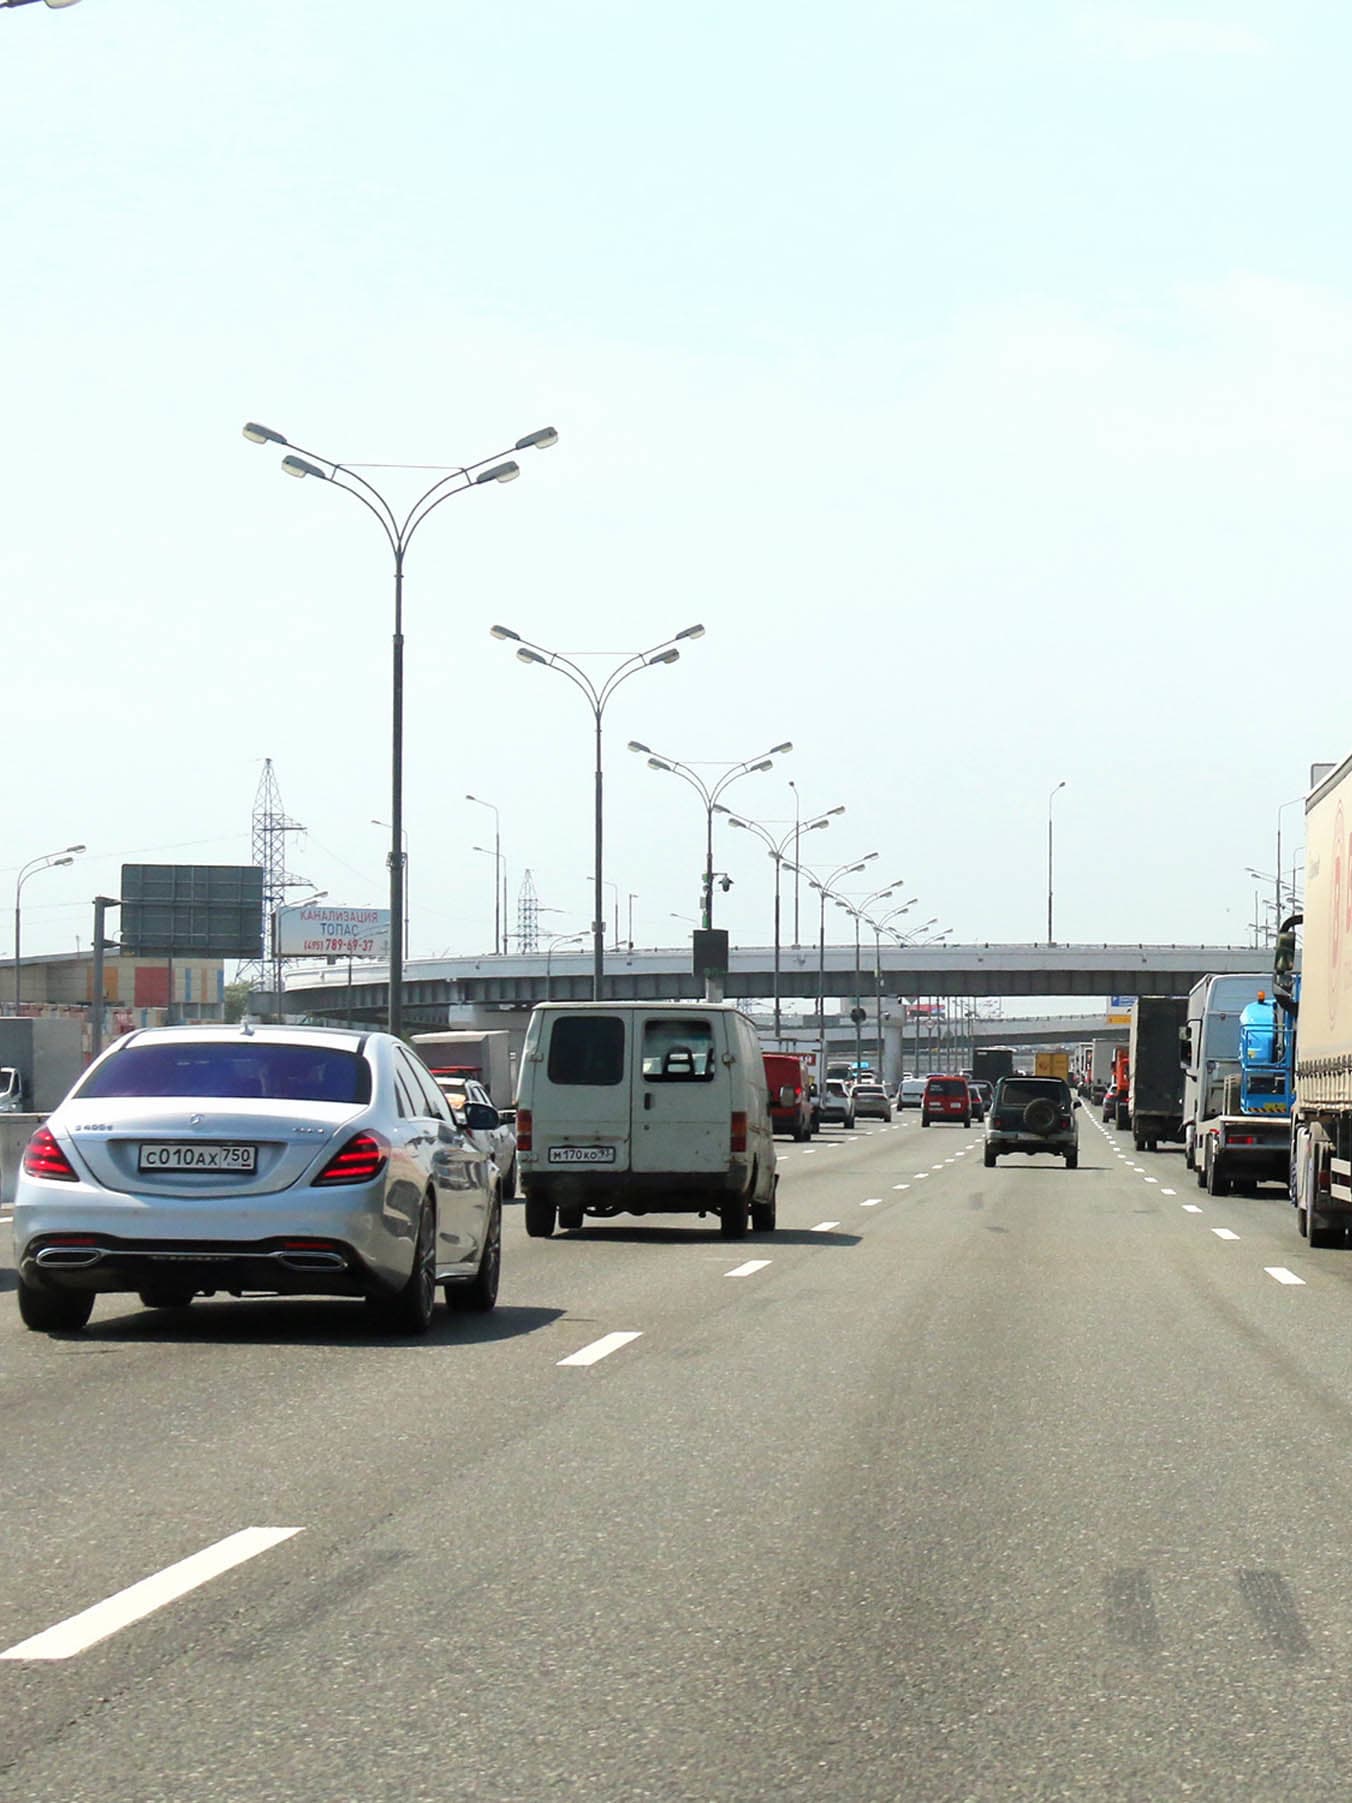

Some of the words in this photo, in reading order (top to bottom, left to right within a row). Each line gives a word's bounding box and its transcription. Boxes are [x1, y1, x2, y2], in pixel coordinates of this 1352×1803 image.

[301, 910, 378, 923] КАНАЛИЗАЦИЯ
[320, 922, 361, 937] ТОПАС
[304, 940, 324, 951] (495)
